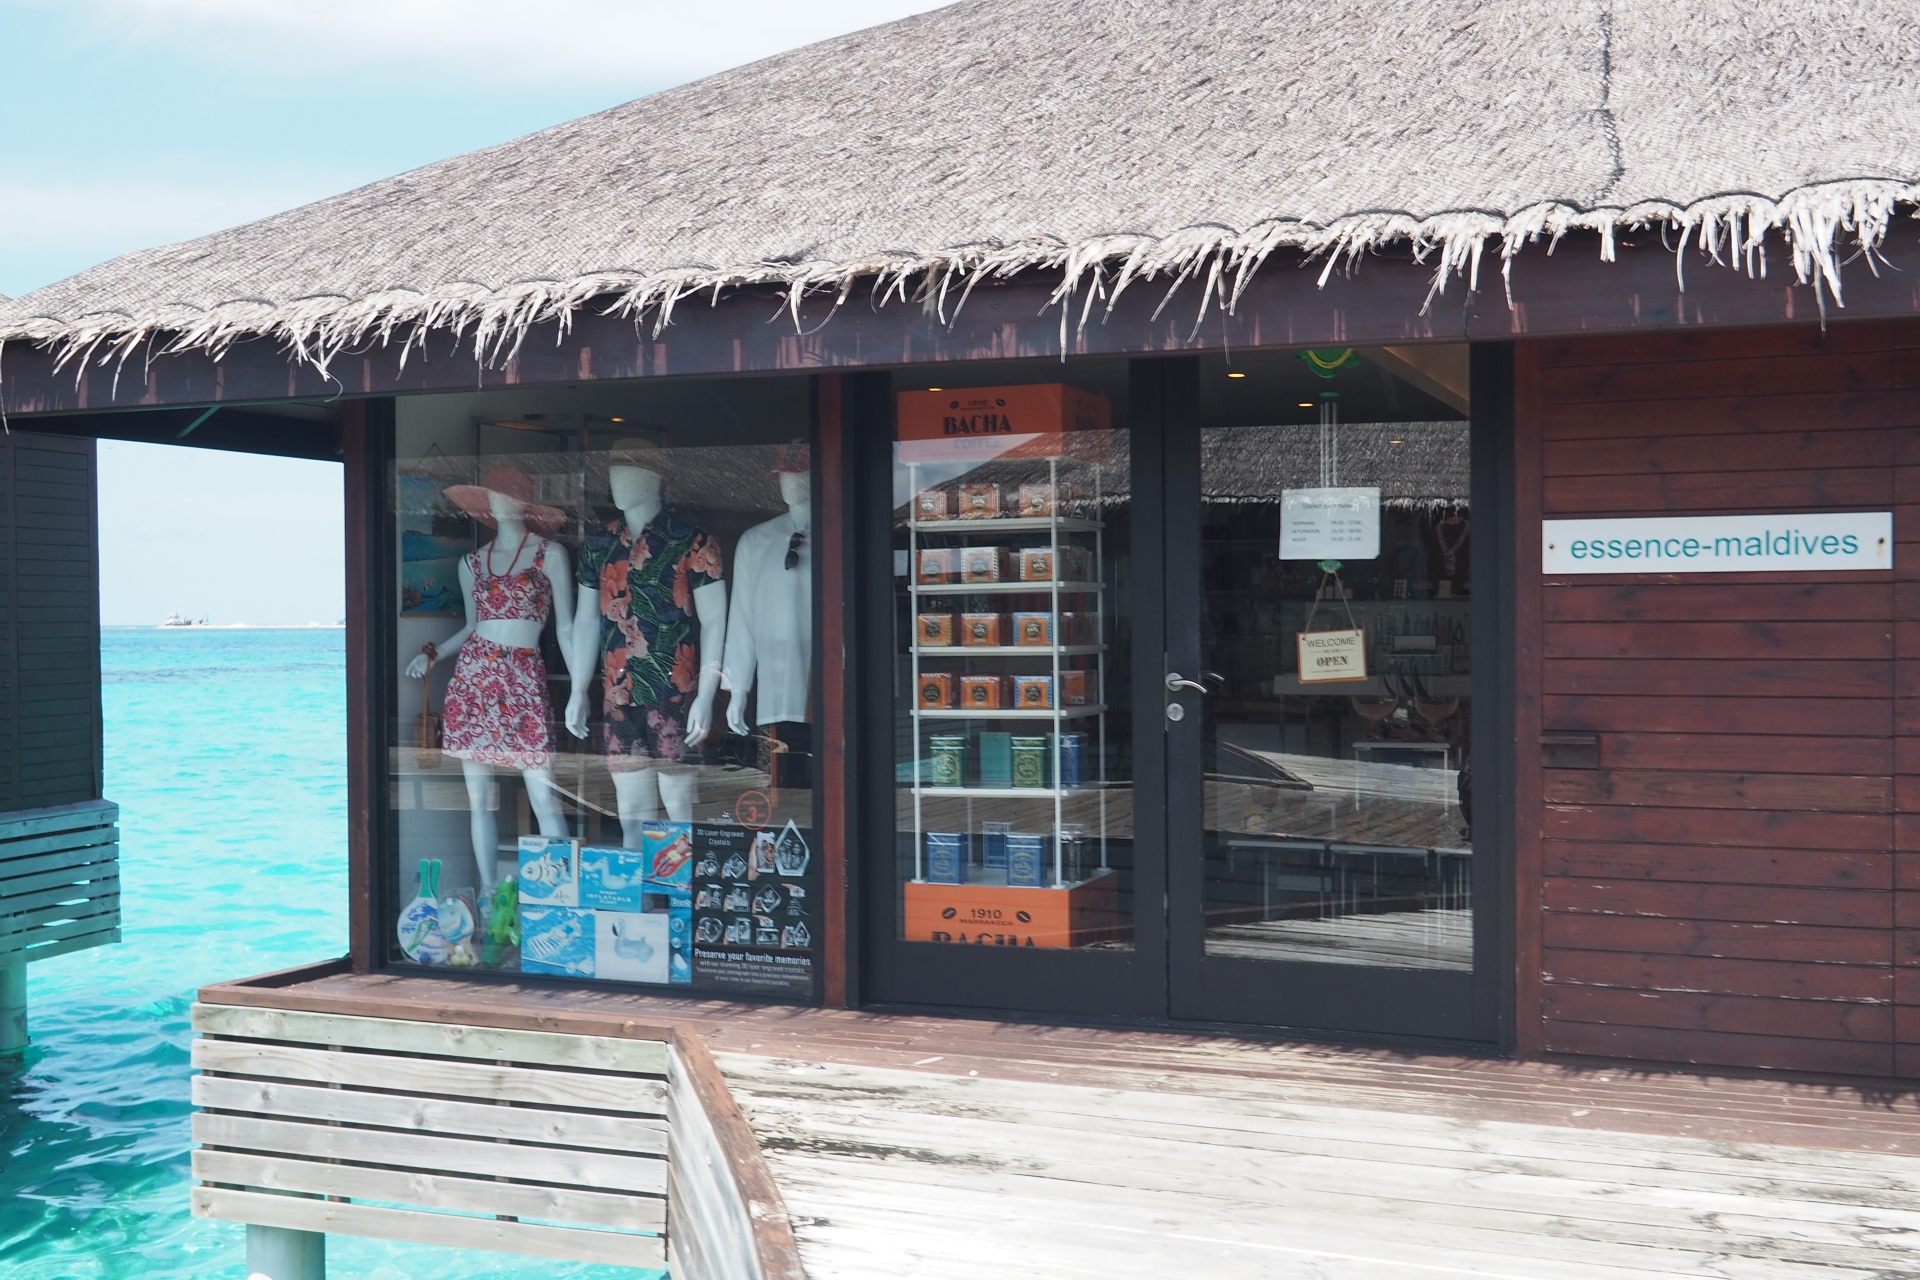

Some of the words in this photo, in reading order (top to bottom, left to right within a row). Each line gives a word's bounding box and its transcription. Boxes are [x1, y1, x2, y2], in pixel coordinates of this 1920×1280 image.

[943, 414, 1012, 435] BACHA
[954, 437, 1002, 449] COFFEE
[1571, 529, 1859, 559] essence-maldives
[1306, 636, 1357, 648] WELCOME
[1316, 655, 1349, 667] OPEN
[971, 908, 1002, 920] 1910
[959, 918, 1014, 927] MARRAKECH
[694, 947, 727, 960] Preserve
[727, 952, 744, 962] your
[745, 951, 774, 963] favorite
[775, 955, 812, 966] memories
